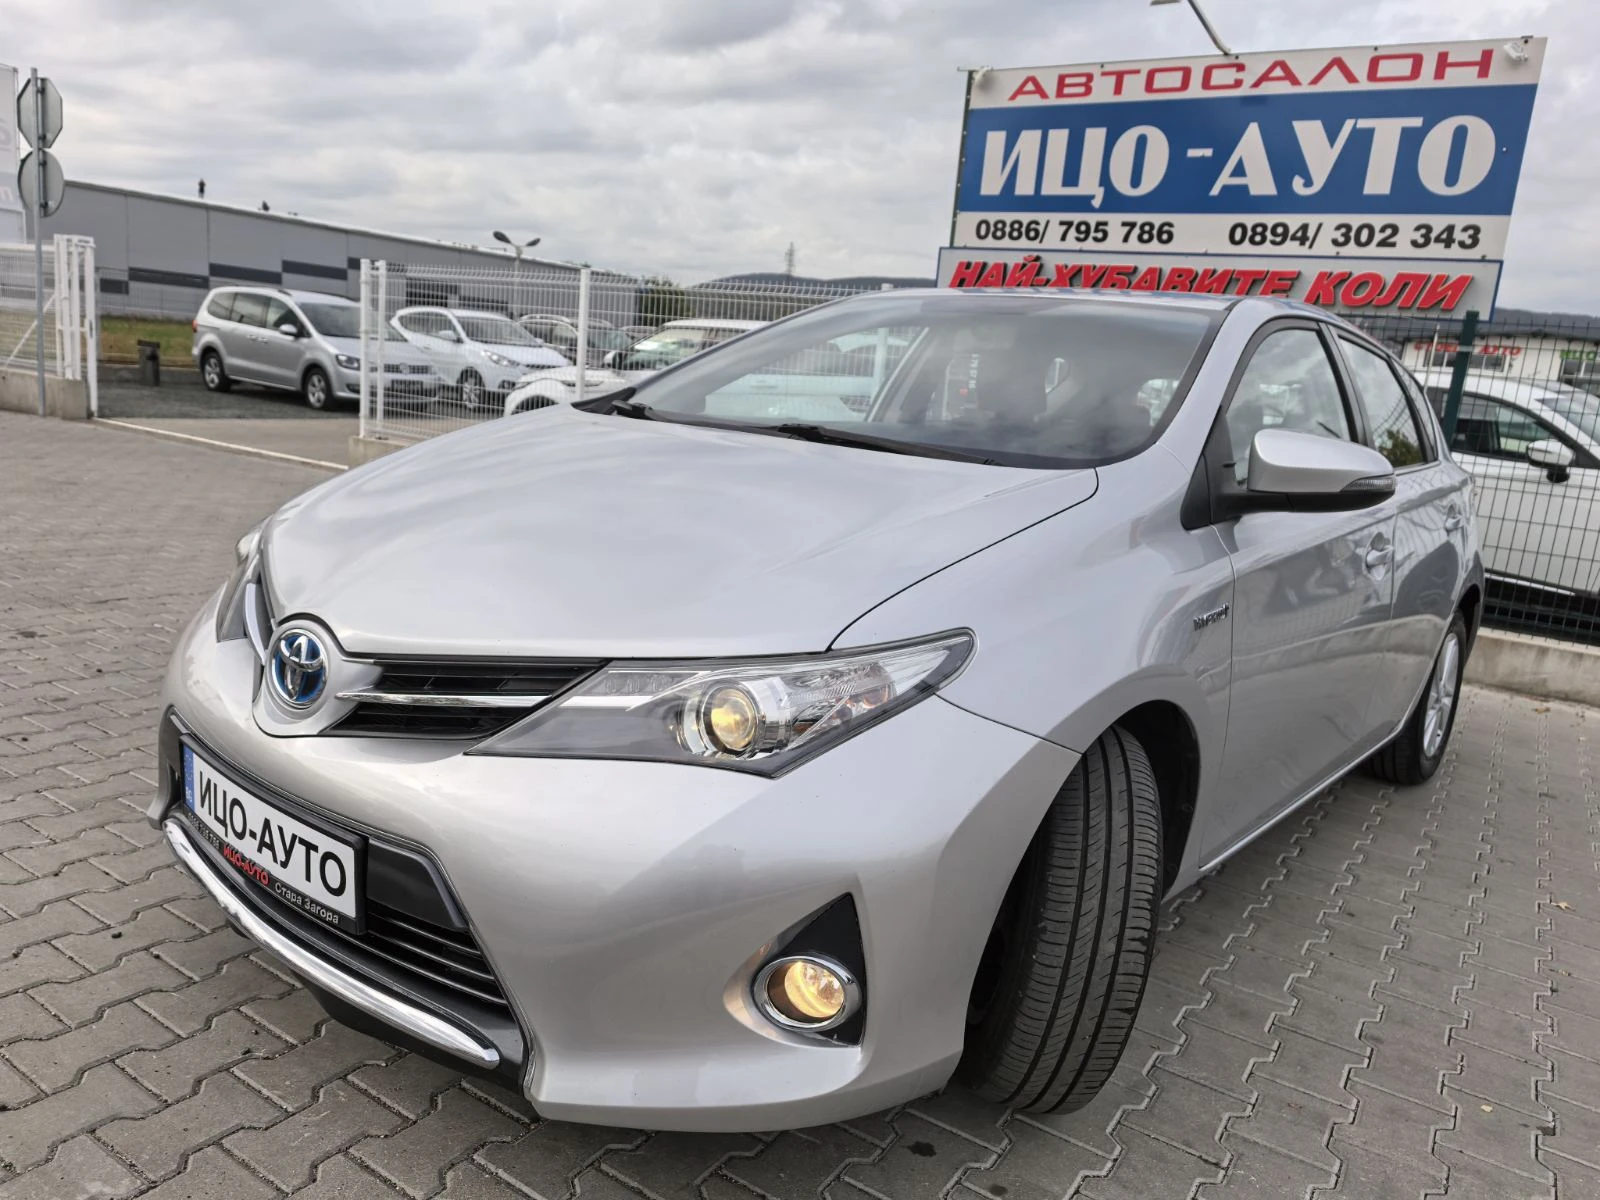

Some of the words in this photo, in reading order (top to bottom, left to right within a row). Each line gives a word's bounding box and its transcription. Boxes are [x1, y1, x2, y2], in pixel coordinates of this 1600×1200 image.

[1007, 49, 1494, 100] АВТОСАЛОН
[974, 219, 1050, 244] 0886/
[1058, 220, 1110, 244] 795
[1120, 221, 1175, 245] 786
[1228, 222, 1322, 249] 0894/
[1331, 223, 1399, 249] 302
[1410, 224, 1481, 250] 343
[1303, 271, 1476, 311] КОЛИ
[200, 770, 347, 897] ИЦО-АУТО
[223, 842, 270, 886] ИЦО-АУТО
[275, 882, 302, 905] Стара
[304, 898, 339, 925] Загора
